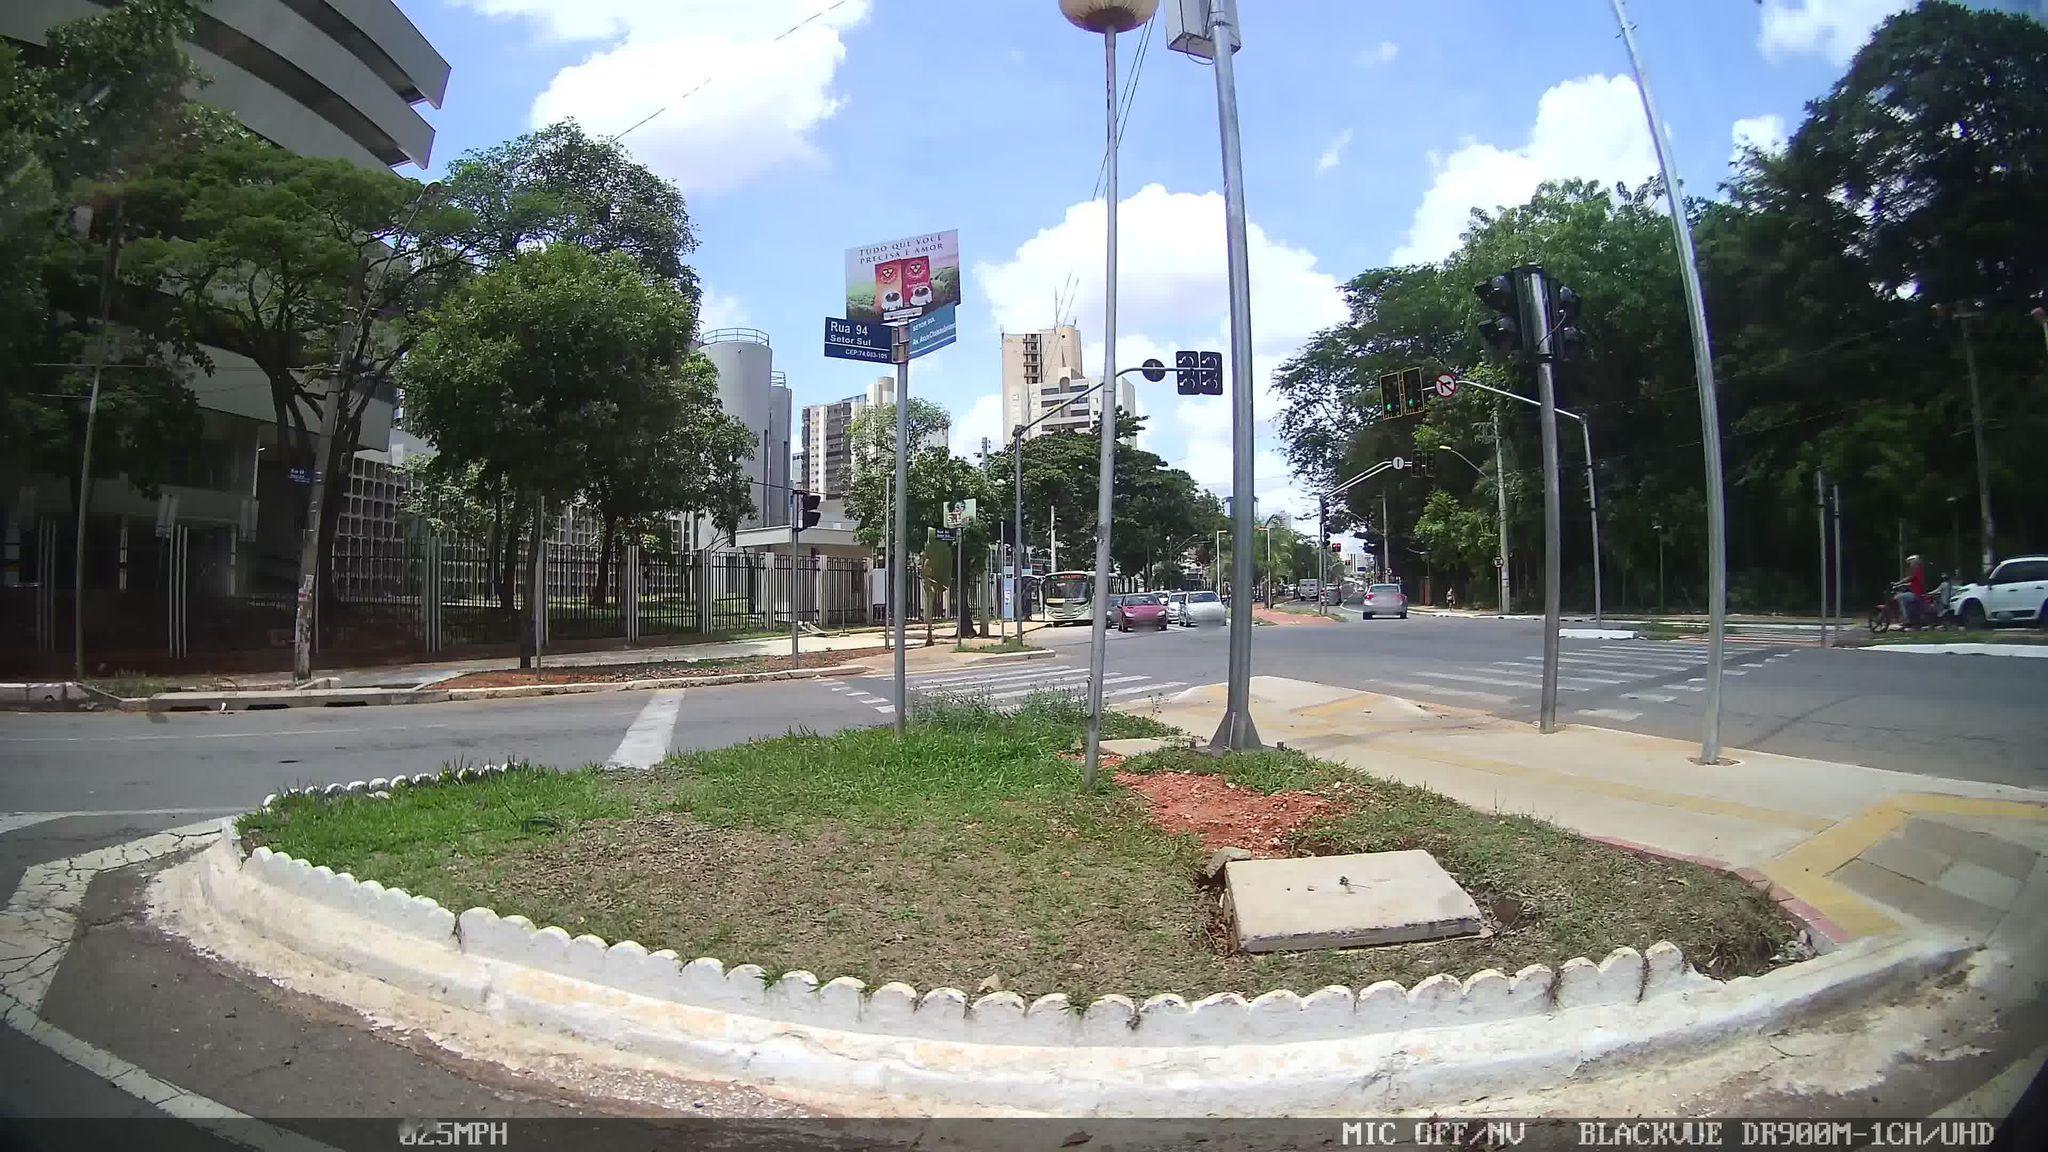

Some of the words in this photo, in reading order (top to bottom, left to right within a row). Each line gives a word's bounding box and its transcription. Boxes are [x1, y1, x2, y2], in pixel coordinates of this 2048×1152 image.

[859, 245, 887, 256] TUDO
[860, 252, 900, 264] PRECISA
[914, 243, 943, 254] AMOR
[830, 321, 850, 334] Rua
[856, 324, 868, 336] 94
[830, 334, 855, 344] Setor
[856, 337, 871, 346] Sul
